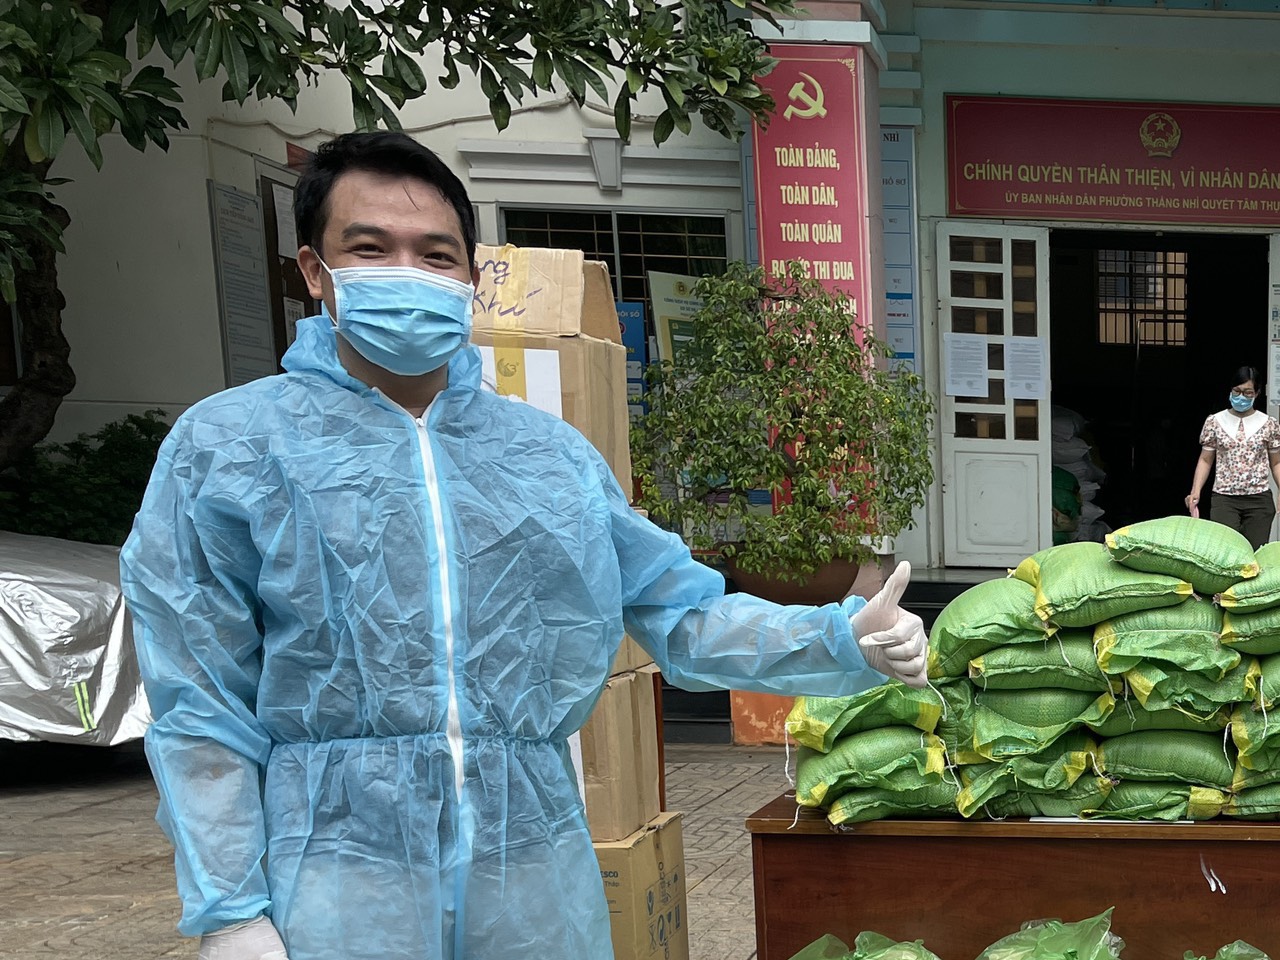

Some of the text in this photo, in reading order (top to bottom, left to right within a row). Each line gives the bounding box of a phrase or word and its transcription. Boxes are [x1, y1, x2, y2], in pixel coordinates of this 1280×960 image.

[775, 142, 840, 170] TOÀN ĐẢNG,
[963, 159, 1013, 181] CHÍNH
[1017, 162, 1073, 183] QUYỀN
[1078, 163, 1120, 185] THÂN
[1125, 165, 1175, 190] THIỆN,
[1180, 165, 1195, 187] VÌ
[1199, 167, 1244, 188] NHÂN
[1248, 168, 1280, 190] DÂN
[780, 181, 839, 208] TOÀN DÂN,
[1021, 193, 1042, 204] BAN
[1044, 193, 1073, 205] NHÂN
[1075, 193, 1097, 206] DÂN
[1099, 193, 1143, 207] PHƯỜNG
[1237, 197, 1258, 211] TÂM
[780, 219, 842, 245] TOÀN QUÂN
[813, 261, 831, 280] THI
[833, 261, 855, 281] ĐUA
